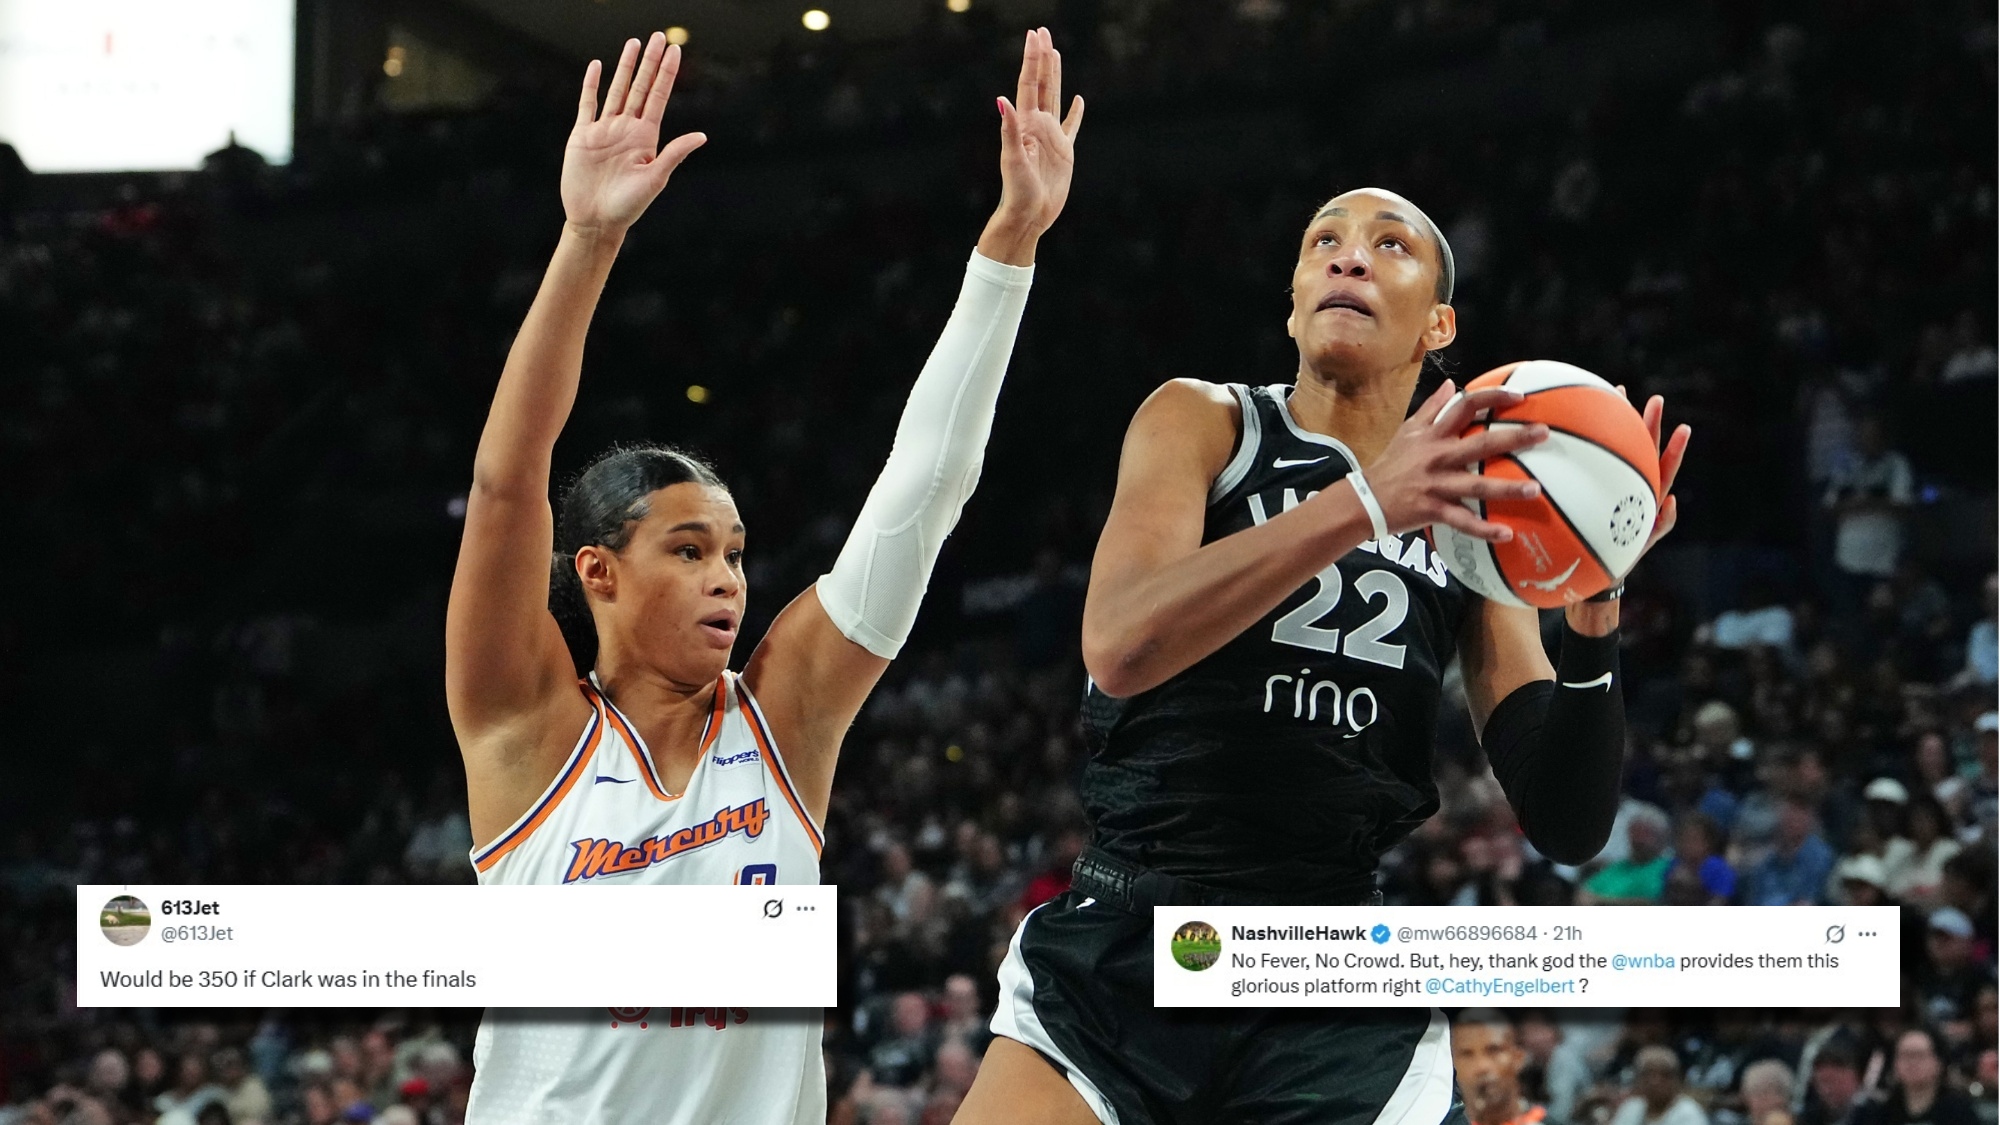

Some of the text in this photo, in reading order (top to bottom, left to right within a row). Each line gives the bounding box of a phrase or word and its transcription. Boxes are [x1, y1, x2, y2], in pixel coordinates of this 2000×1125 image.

[1271, 562, 1407, 669] 22
[1264, 668, 1378, 739] ring
[563, 797, 771, 884] Mercury
